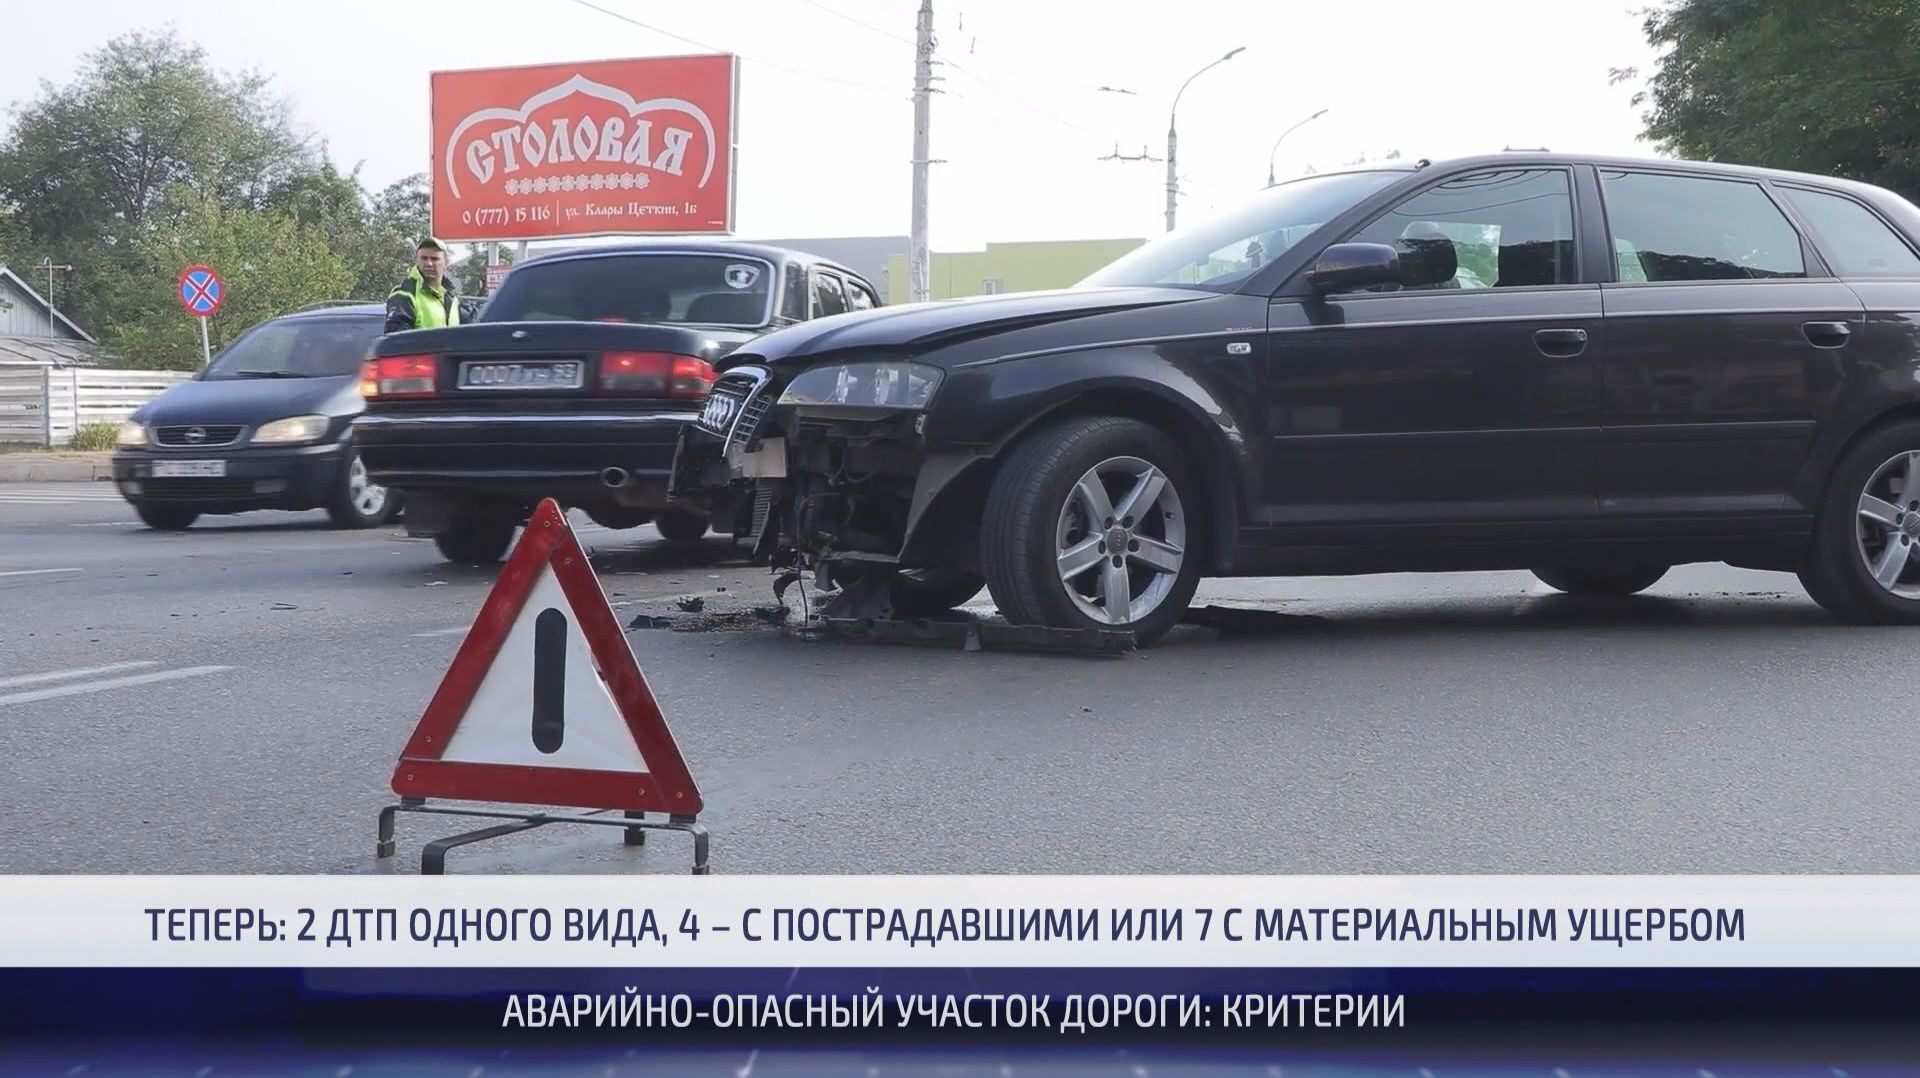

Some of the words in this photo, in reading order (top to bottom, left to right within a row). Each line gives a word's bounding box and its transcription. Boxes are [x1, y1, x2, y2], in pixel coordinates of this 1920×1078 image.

[466, 115, 693, 184] СТОЛОВАЯ
[462, 210, 471, 224] 0
[475, 206, 509, 226] (777)
[516, 207, 527, 222] 15
[531, 205, 550, 221] 116
[565, 207, 580, 220] ул.
[585, 203, 623, 219] Клары
[628, 202, 679, 218] Цеткин,
